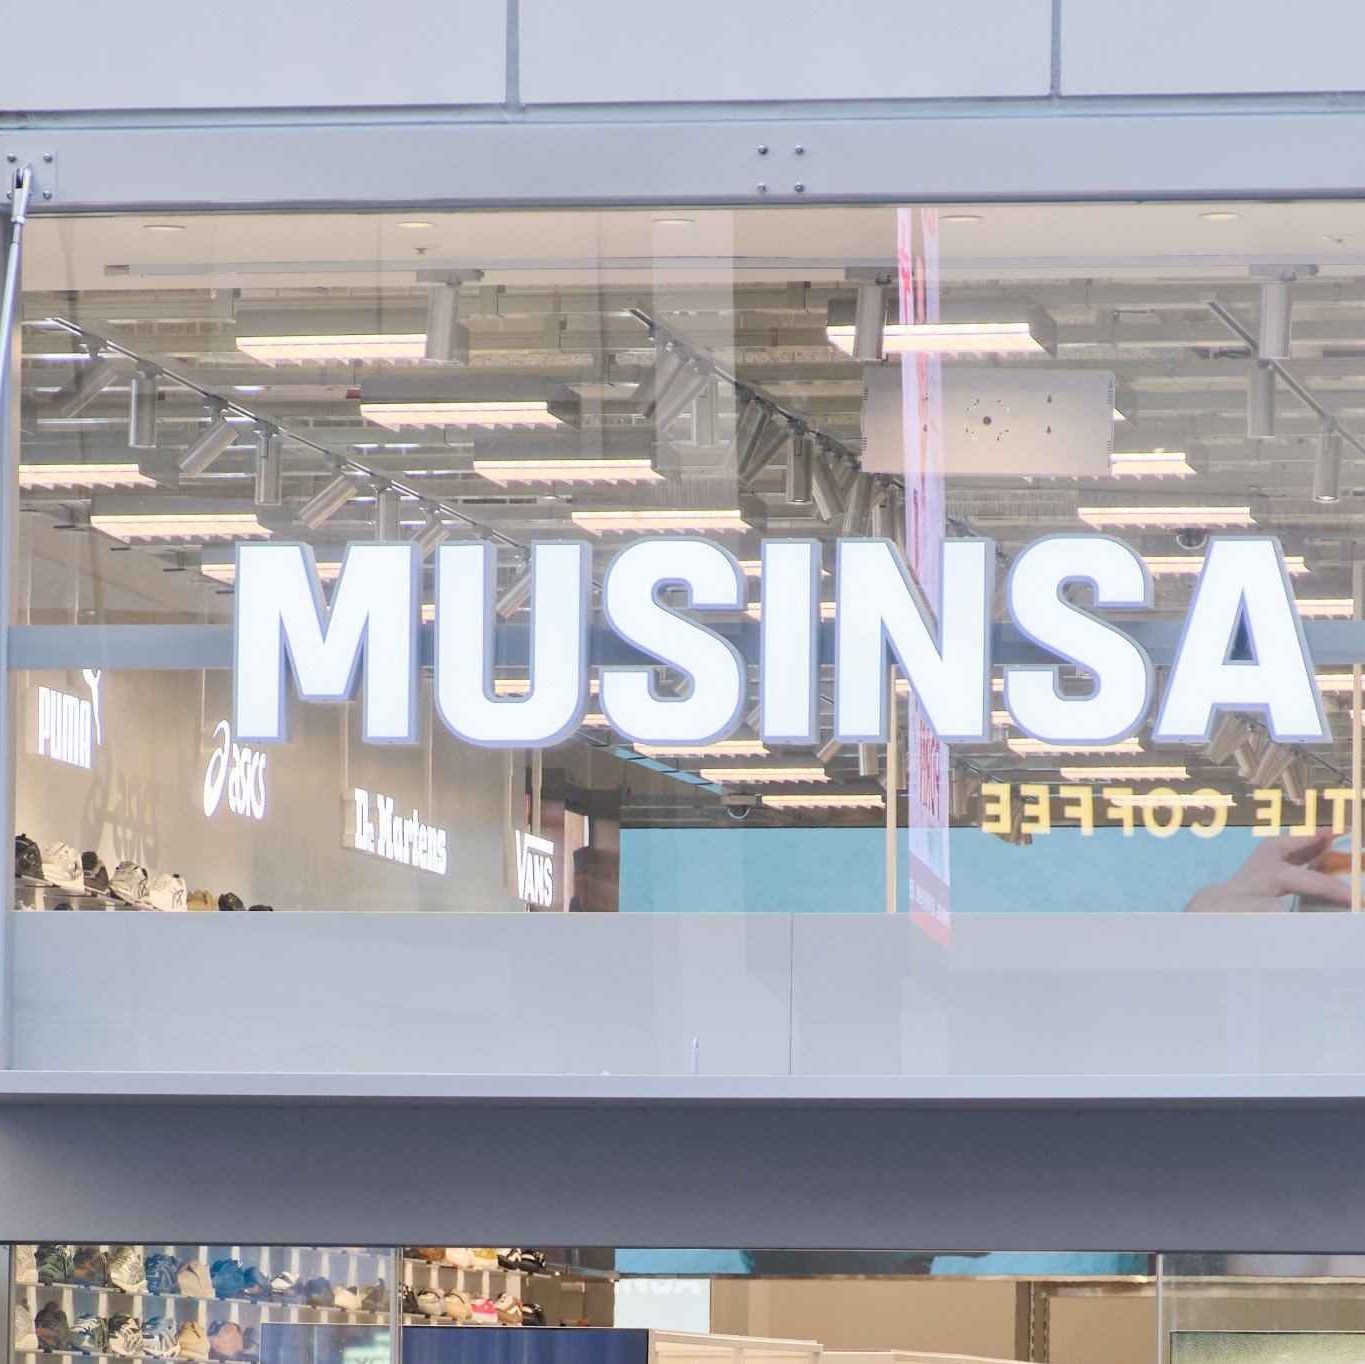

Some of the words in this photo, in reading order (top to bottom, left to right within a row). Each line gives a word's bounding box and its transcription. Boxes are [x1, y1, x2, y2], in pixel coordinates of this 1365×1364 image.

[234, 534, 1332, 748] MUSINSA
[38, 685, 92, 770] PUMA
[376, 793, 449, 877] Martens
[515, 829, 556, 908] VANS
